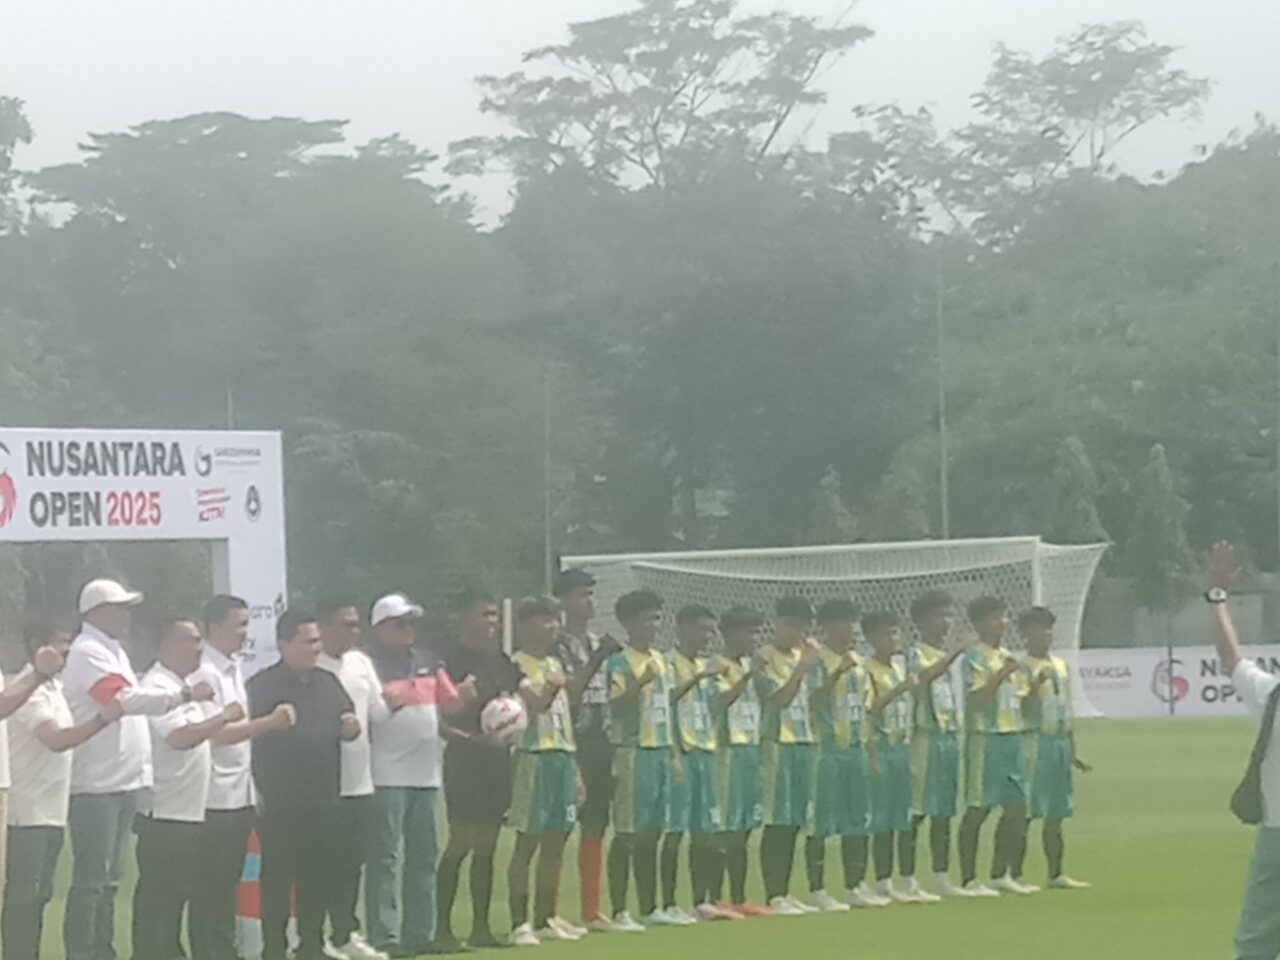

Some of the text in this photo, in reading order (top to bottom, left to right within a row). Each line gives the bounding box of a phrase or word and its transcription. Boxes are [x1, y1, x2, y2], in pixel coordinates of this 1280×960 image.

[25, 441, 187, 477] NUSANTARA
[29, 490, 102, 528] OPEN
[105, 489, 162, 527] 2025
